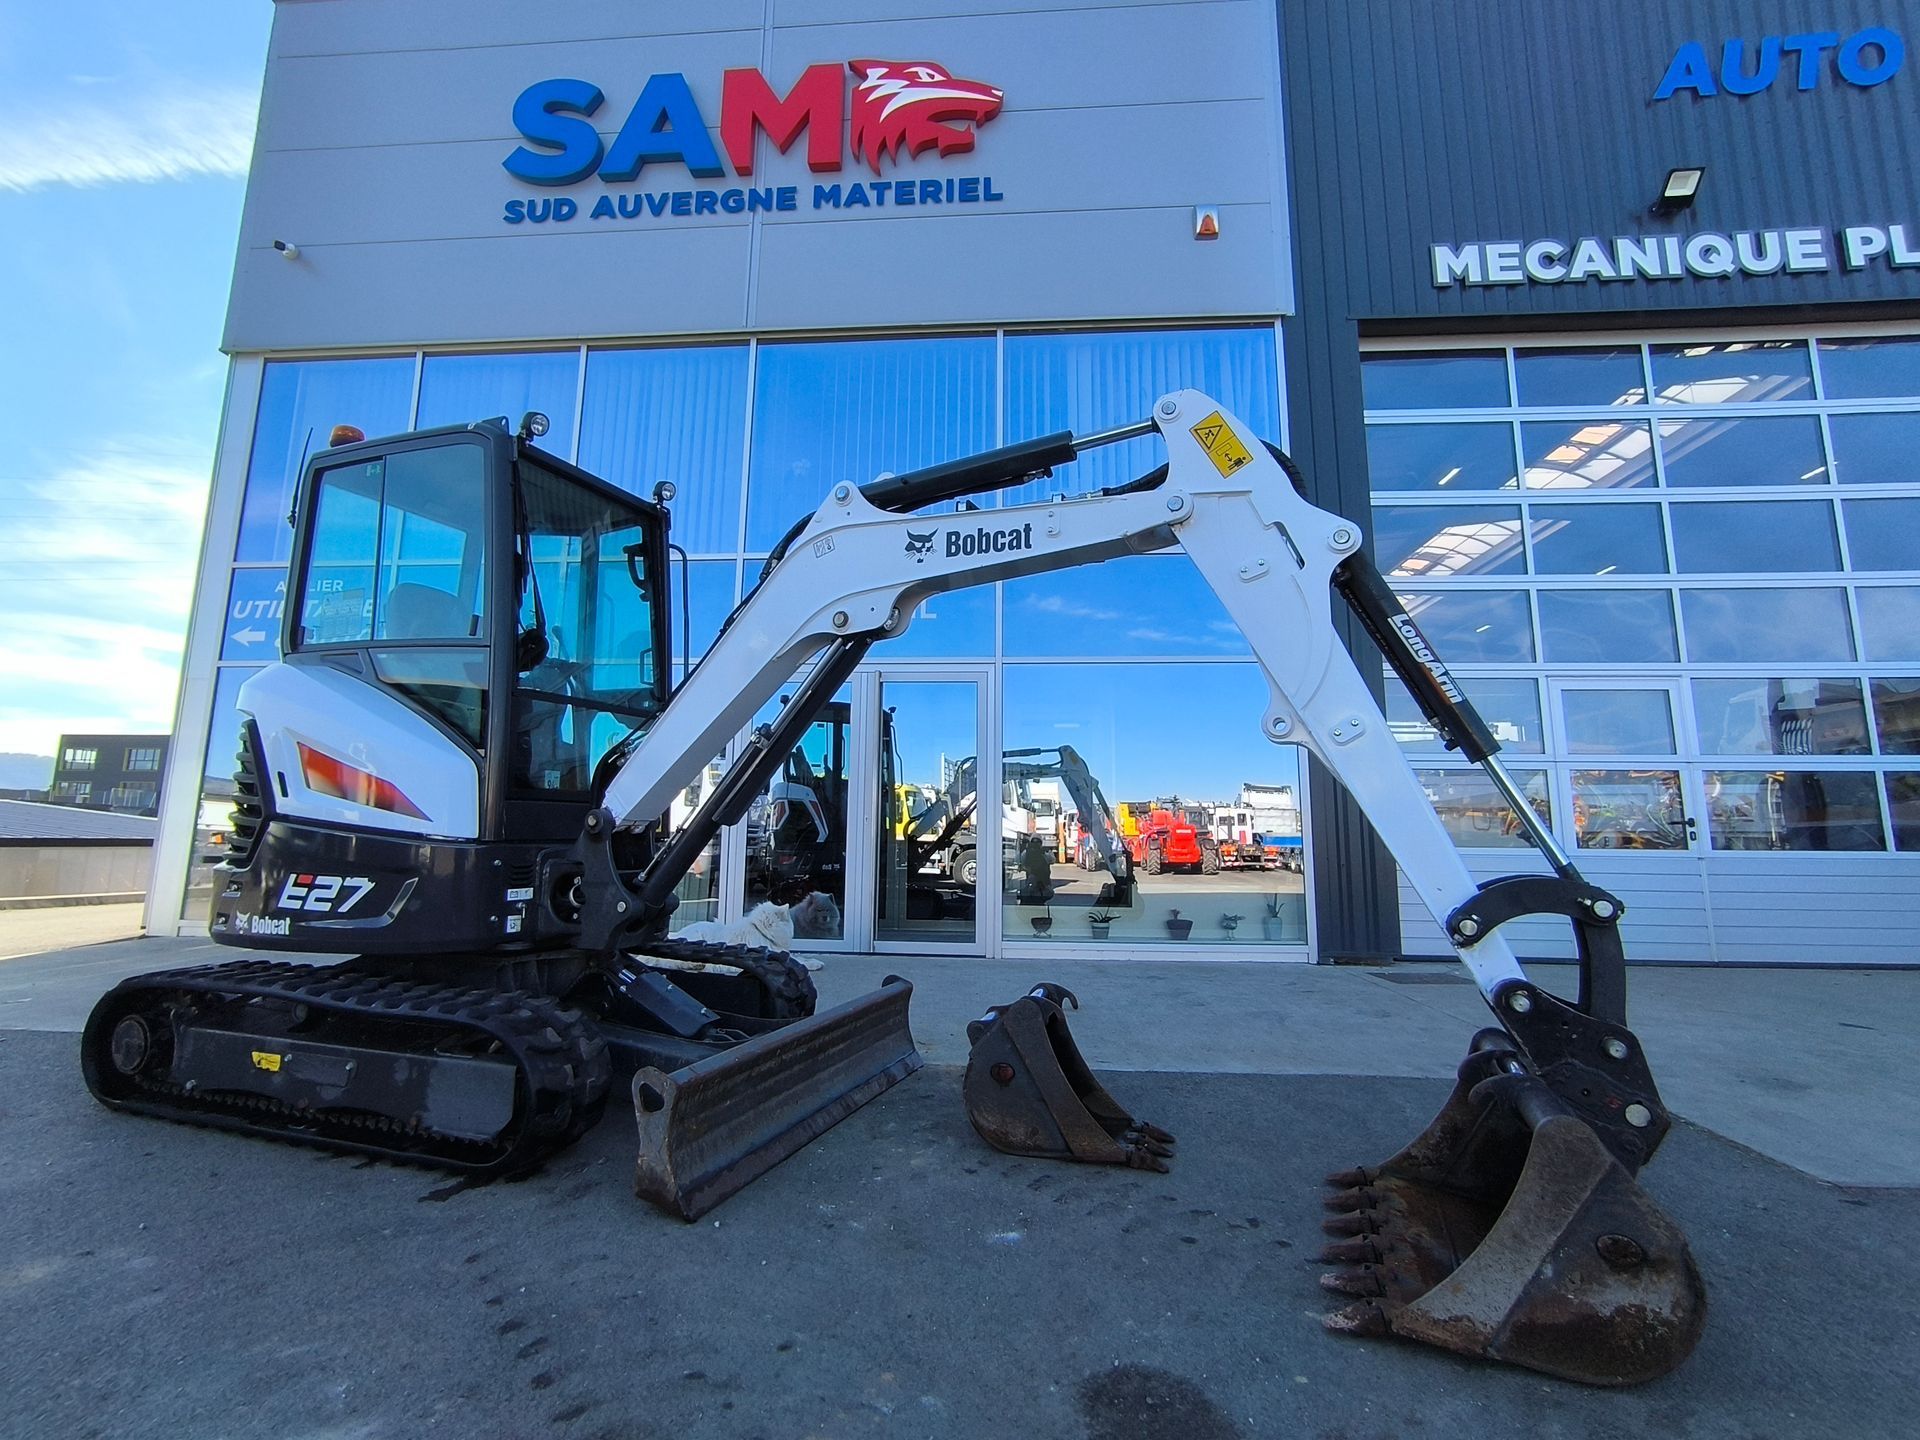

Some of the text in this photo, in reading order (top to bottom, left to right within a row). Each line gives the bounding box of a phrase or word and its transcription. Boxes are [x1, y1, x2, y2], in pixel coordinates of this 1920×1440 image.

[1653, 27, 1906, 100] AUTO
[501, 63, 844, 185] SAM
[502, 176, 1003, 223] SUD AUVERGNE MATERIEL
[1432, 227, 1829, 286] MECANIQUE
[945, 523, 1032, 557] Bobcat
[277, 873, 375, 912] E27
[251, 915, 290, 935] Bobcat
